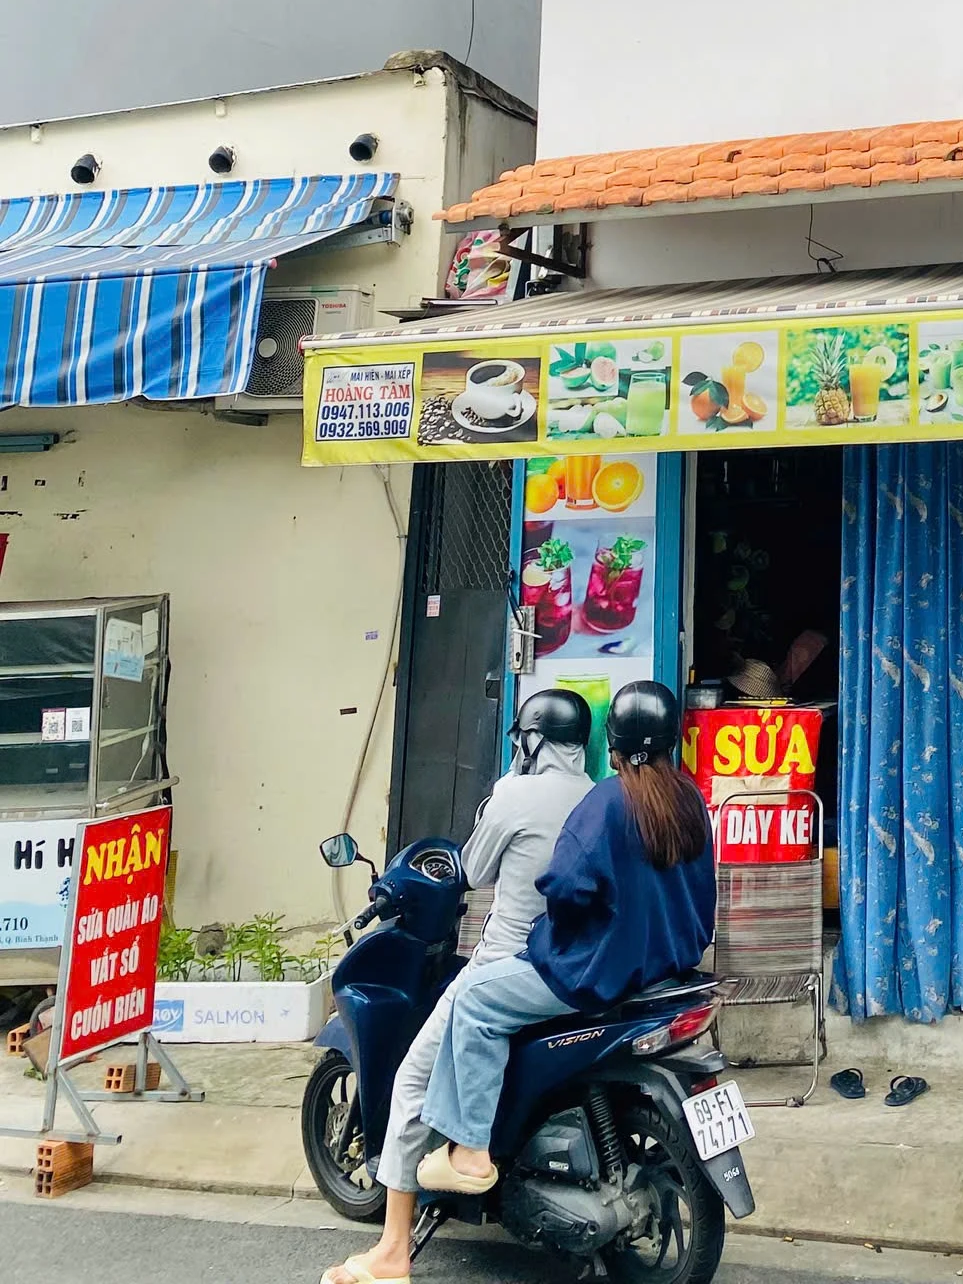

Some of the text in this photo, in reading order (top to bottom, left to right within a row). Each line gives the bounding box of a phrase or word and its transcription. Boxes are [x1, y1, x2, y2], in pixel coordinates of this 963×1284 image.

[324, 381, 411, 402] HOÀNG TÂM
[321, 401, 410, 421] 0947.113.006
[319, 419, 407, 438] 0932.569.909
[713, 709, 816, 775] SỬA
[726, 804, 775, 845] DÂY
[779, 804, 815, 845] KÉ
[13, 839, 46, 870] Hí
[83, 822, 165, 886] NHẬN
[76, 893, 159, 945] SỬA QUẦN ÁO
[90, 935, 140, 988] VẮT SỔ
[70, 994, 112, 1041] CUỐN
[154, 1008, 179, 1021] RØY
[194, 1009, 265, 1025] SALMON
[547, 1028, 606, 1049] VISION
